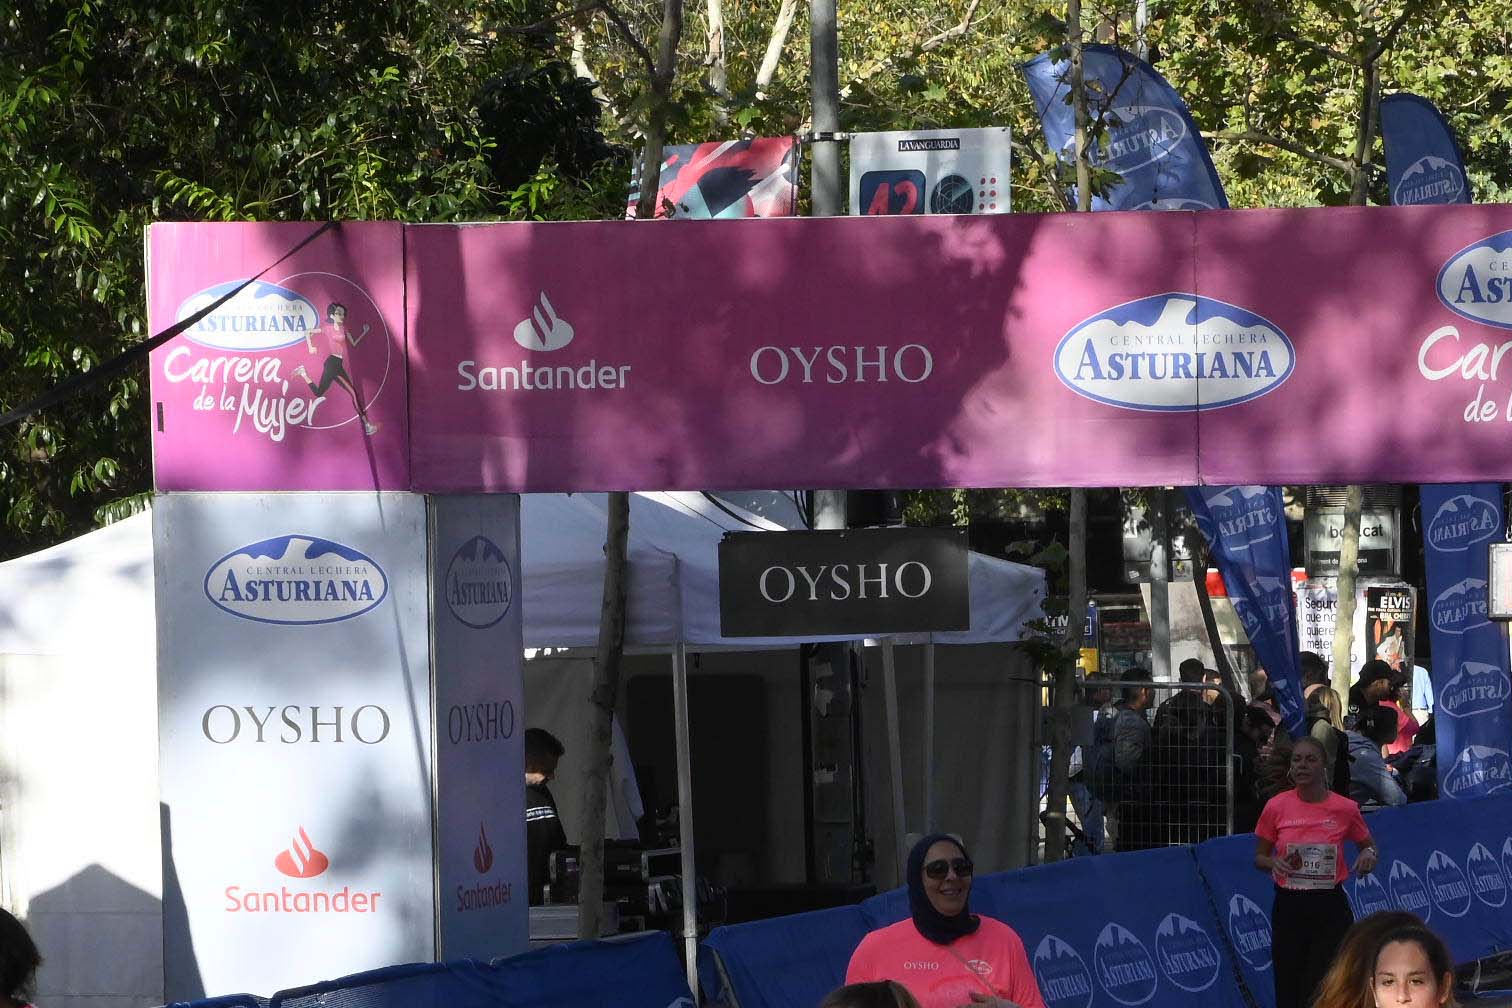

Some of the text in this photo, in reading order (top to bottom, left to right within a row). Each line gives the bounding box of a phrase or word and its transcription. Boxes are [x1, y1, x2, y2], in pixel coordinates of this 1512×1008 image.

[1110, 333, 1267, 346] CENTRAL LECHERA
[163, 346, 282, 384] Carrera
[457, 359, 631, 391] Santander
[749, 344, 933, 385] OYSHO
[1073, 337, 1276, 381] ASTURIANA
[193, 377, 327, 441] de la Mujer
[1464, 387, 1498, 422] de
[219, 569, 375, 602] ASTURIANA
[246, 565, 368, 576] CENTRAL LECHERA
[759, 561, 932, 603] OYSHO
[1380, 596, 1410, 609] ELVIS
[202, 705, 391, 745] OYSHO
[448, 700, 515, 745] OYSHO
[225, 885, 381, 914] Santander
[457, 880, 513, 913] Santander
[904, 961, 939, 970] OYSHO
